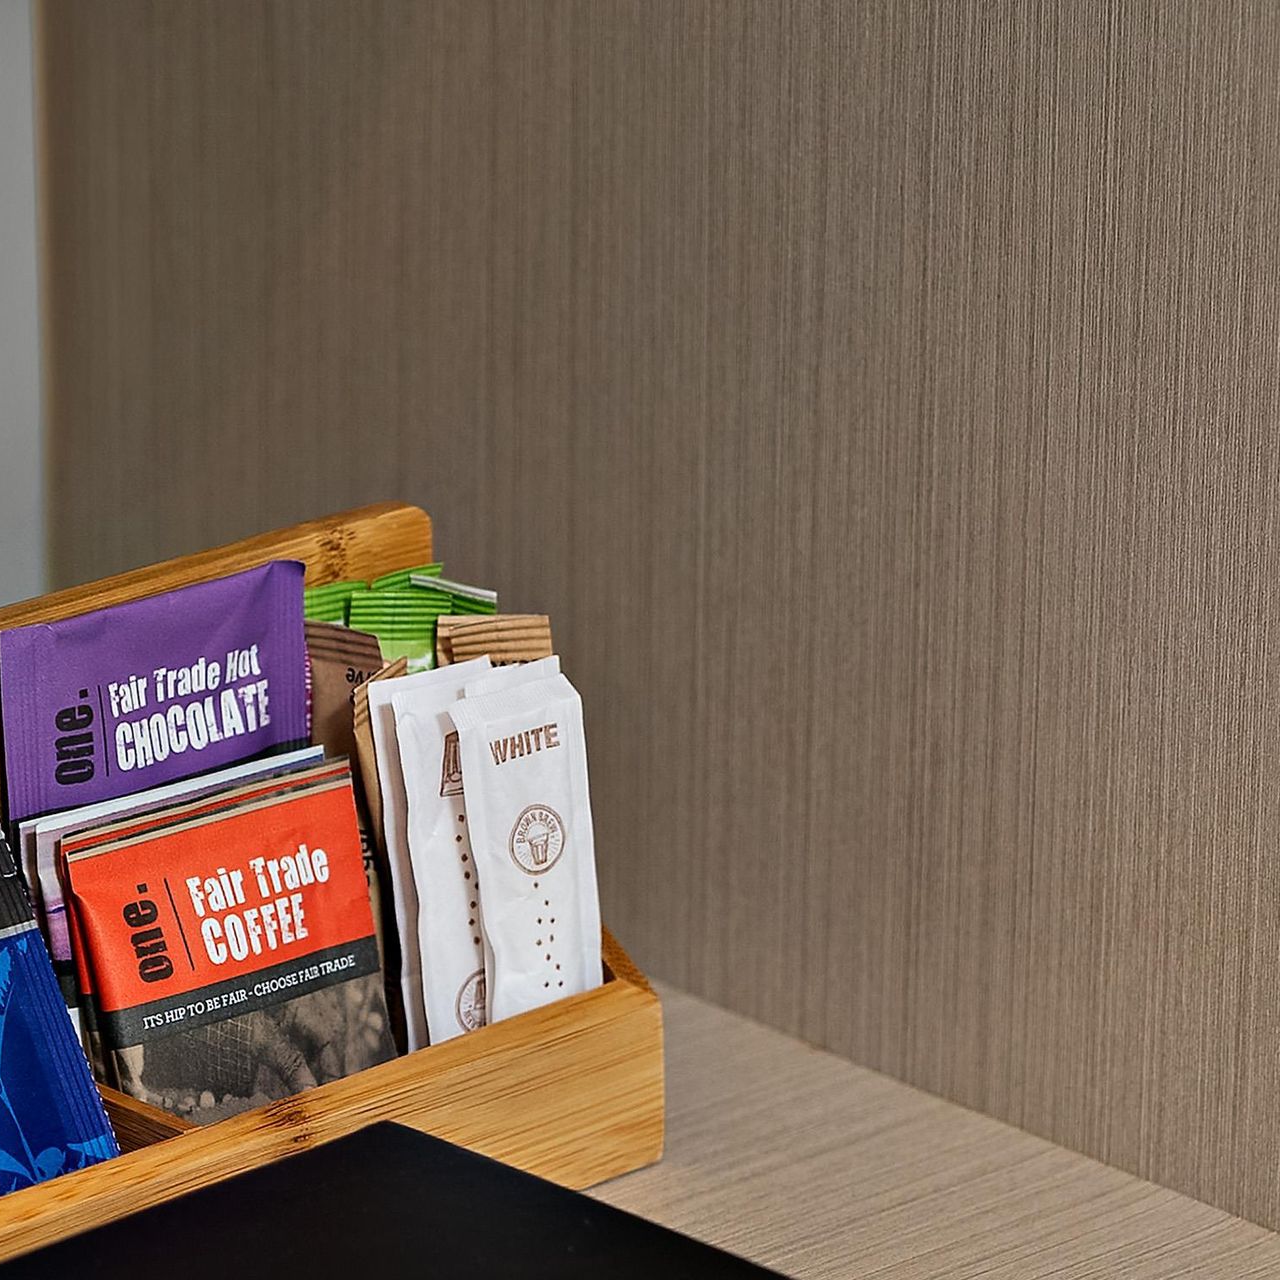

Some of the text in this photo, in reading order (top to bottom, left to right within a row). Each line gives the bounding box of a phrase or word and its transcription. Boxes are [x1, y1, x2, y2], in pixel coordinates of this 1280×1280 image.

[108, 644, 261, 718] Fair Trade Hot
[55, 688, 94, 785] one.
[115, 679, 270, 772] CHOCOLATE
[489, 722, 560, 765] WHITE
[516, 812, 538, 844] BROWN
[186, 864, 247, 918] Fair
[249, 843, 330, 899] Trade
[123, 883, 174, 983] one.
[200, 893, 309, 966] COFFEE
[143, 1012, 164, 1030] ITS
[165, 1006, 187, 1024] HIP
[187, 1001, 205, 1017] TO
[206, 997, 221, 1013] BE
[221, 989, 248, 1009] FAIR
[253, 972, 299, 998] CHOOSE
[299, 965, 321, 984] FAIR
[320, 954, 356, 976] TRADE
